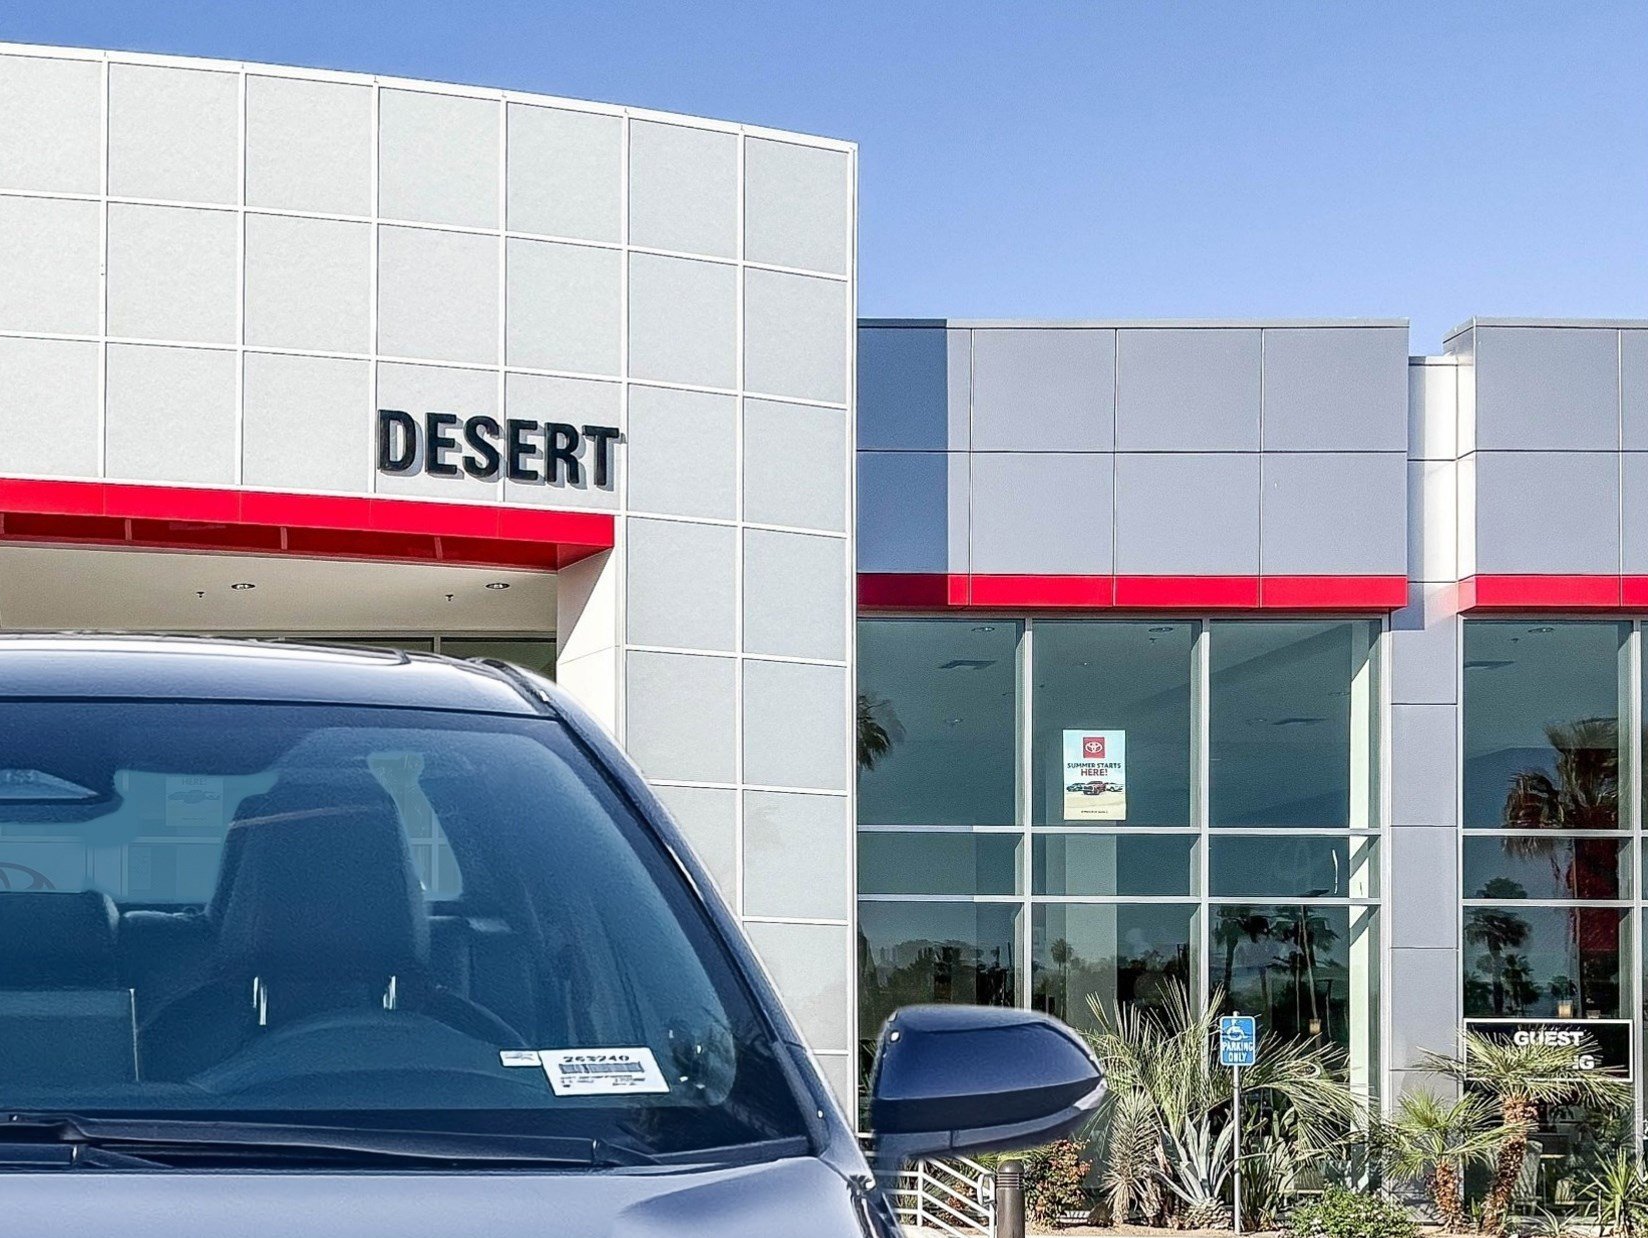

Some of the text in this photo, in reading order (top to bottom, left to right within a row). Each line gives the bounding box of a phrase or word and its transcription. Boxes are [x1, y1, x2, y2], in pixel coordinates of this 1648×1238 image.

[377, 409, 619, 486] DESERT
[1513, 1031, 1584, 1047] GUEST
[1222, 1041, 1254, 1051] PARKING
[1228, 1052, 1247, 1062] ONLY
